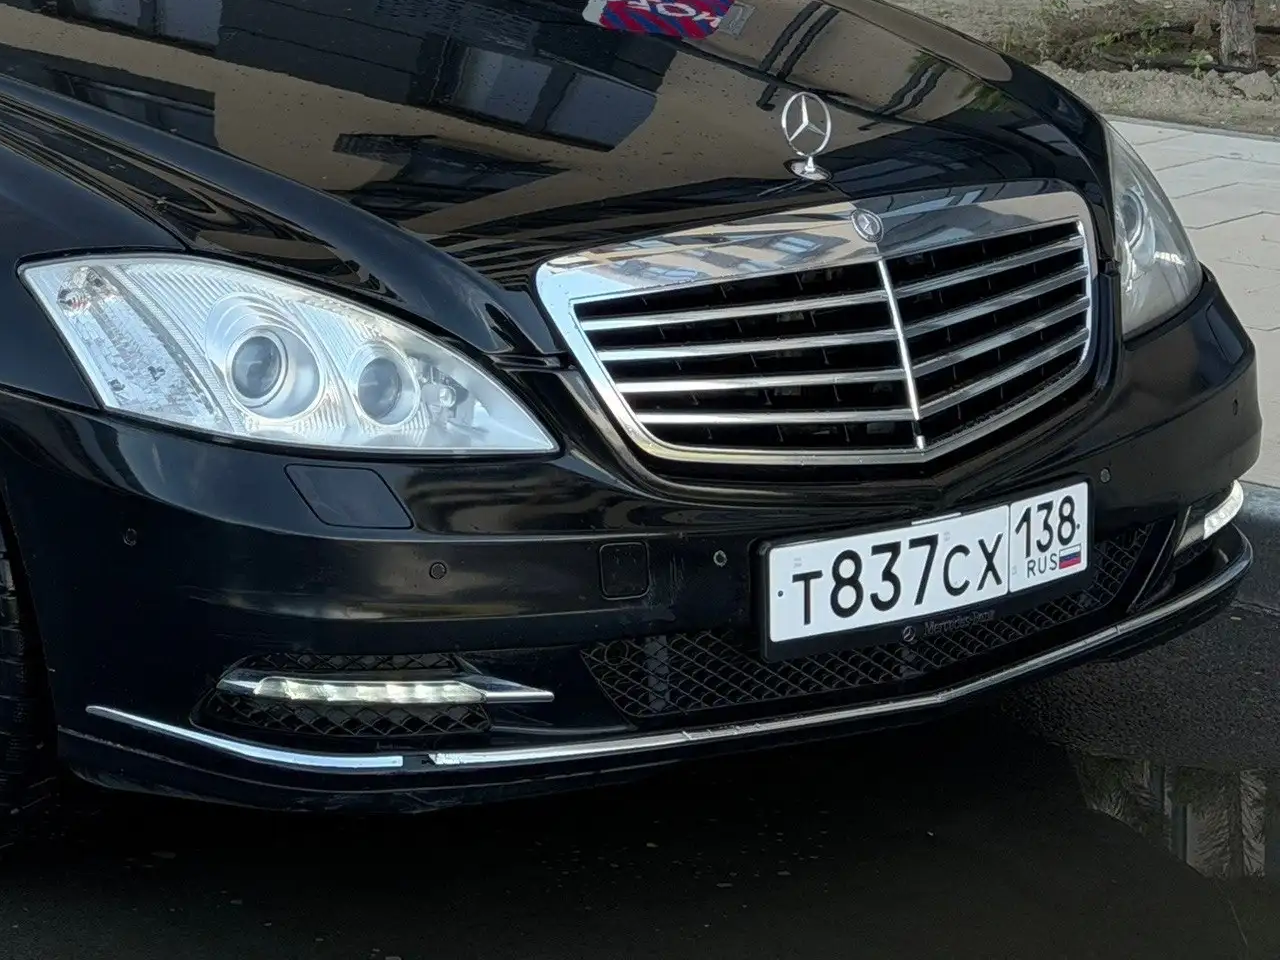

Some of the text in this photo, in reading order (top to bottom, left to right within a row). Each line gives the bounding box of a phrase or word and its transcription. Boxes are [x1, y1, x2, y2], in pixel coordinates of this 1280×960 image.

[1015, 495, 1075, 558] 138
[792, 532, 1004, 625] Т837СХ
[1027, 553, 1058, 578] RUS
